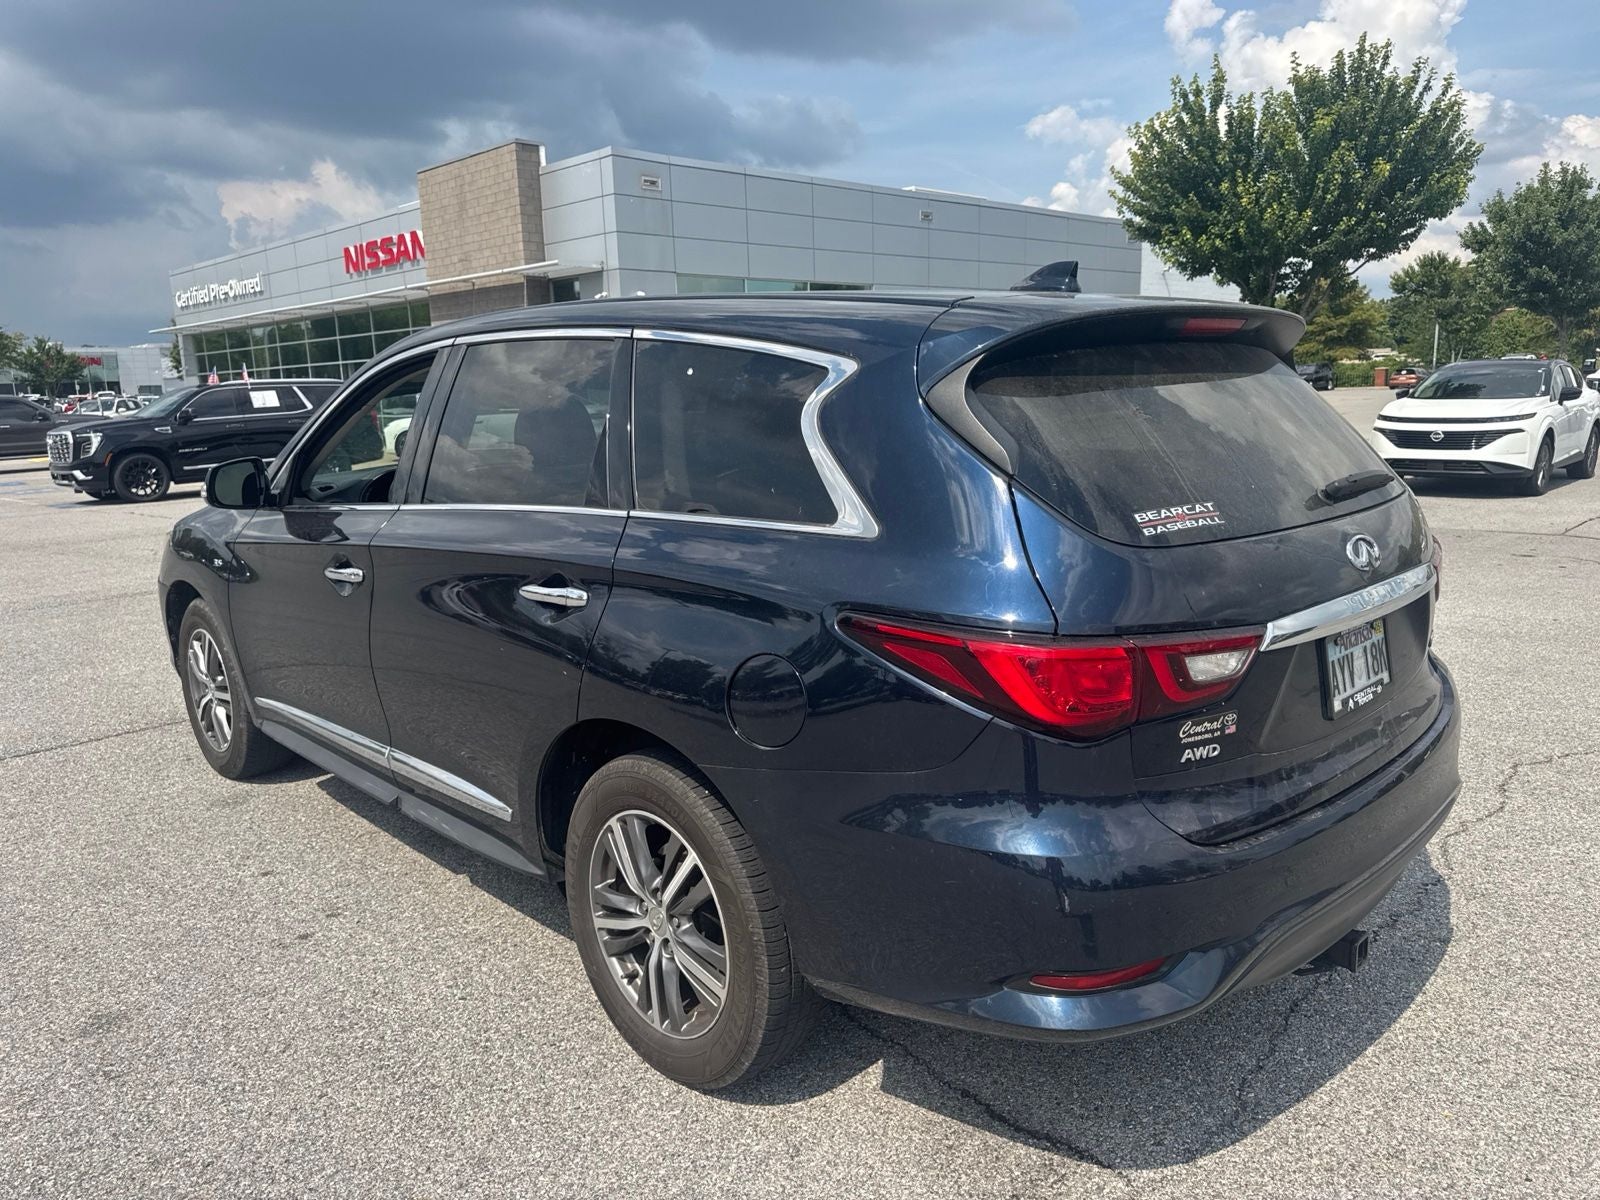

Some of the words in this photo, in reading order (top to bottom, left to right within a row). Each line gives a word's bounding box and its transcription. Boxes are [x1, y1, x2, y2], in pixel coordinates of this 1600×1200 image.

[343, 230, 425, 274] NISSAN
[175, 284, 210, 307] Certified
[210, 272, 263, 301] Pre-Owned
[1134, 502, 1214, 523] BEARCAT
[1142, 516, 1225, 537] BASEBALL
[1331, 652, 1355, 698] AYV
[1364, 637, 1388, 680] 18K
[1353, 684, 1377, 702] CENTRAL
[1179, 716, 1224, 738] Central
[1180, 744, 1221, 763] AWD
